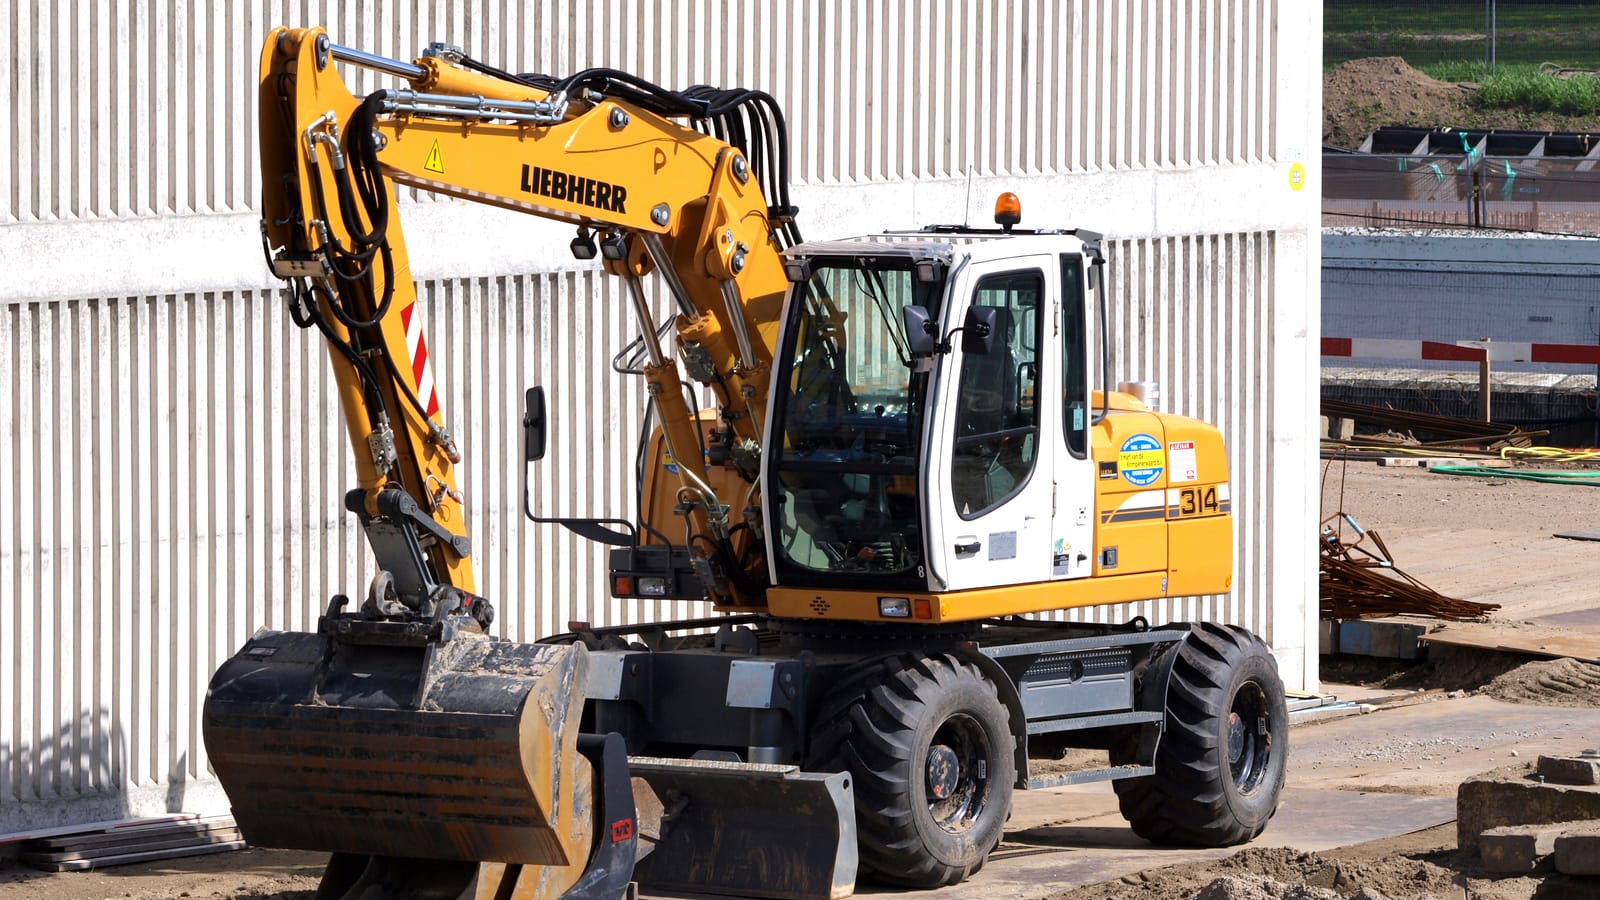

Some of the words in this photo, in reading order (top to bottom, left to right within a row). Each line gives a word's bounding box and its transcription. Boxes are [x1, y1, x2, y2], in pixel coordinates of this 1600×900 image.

[520, 164, 627, 214] LIEBHERR
[1181, 487, 1218, 515] 314
[918, 565, 925, 578] 8
